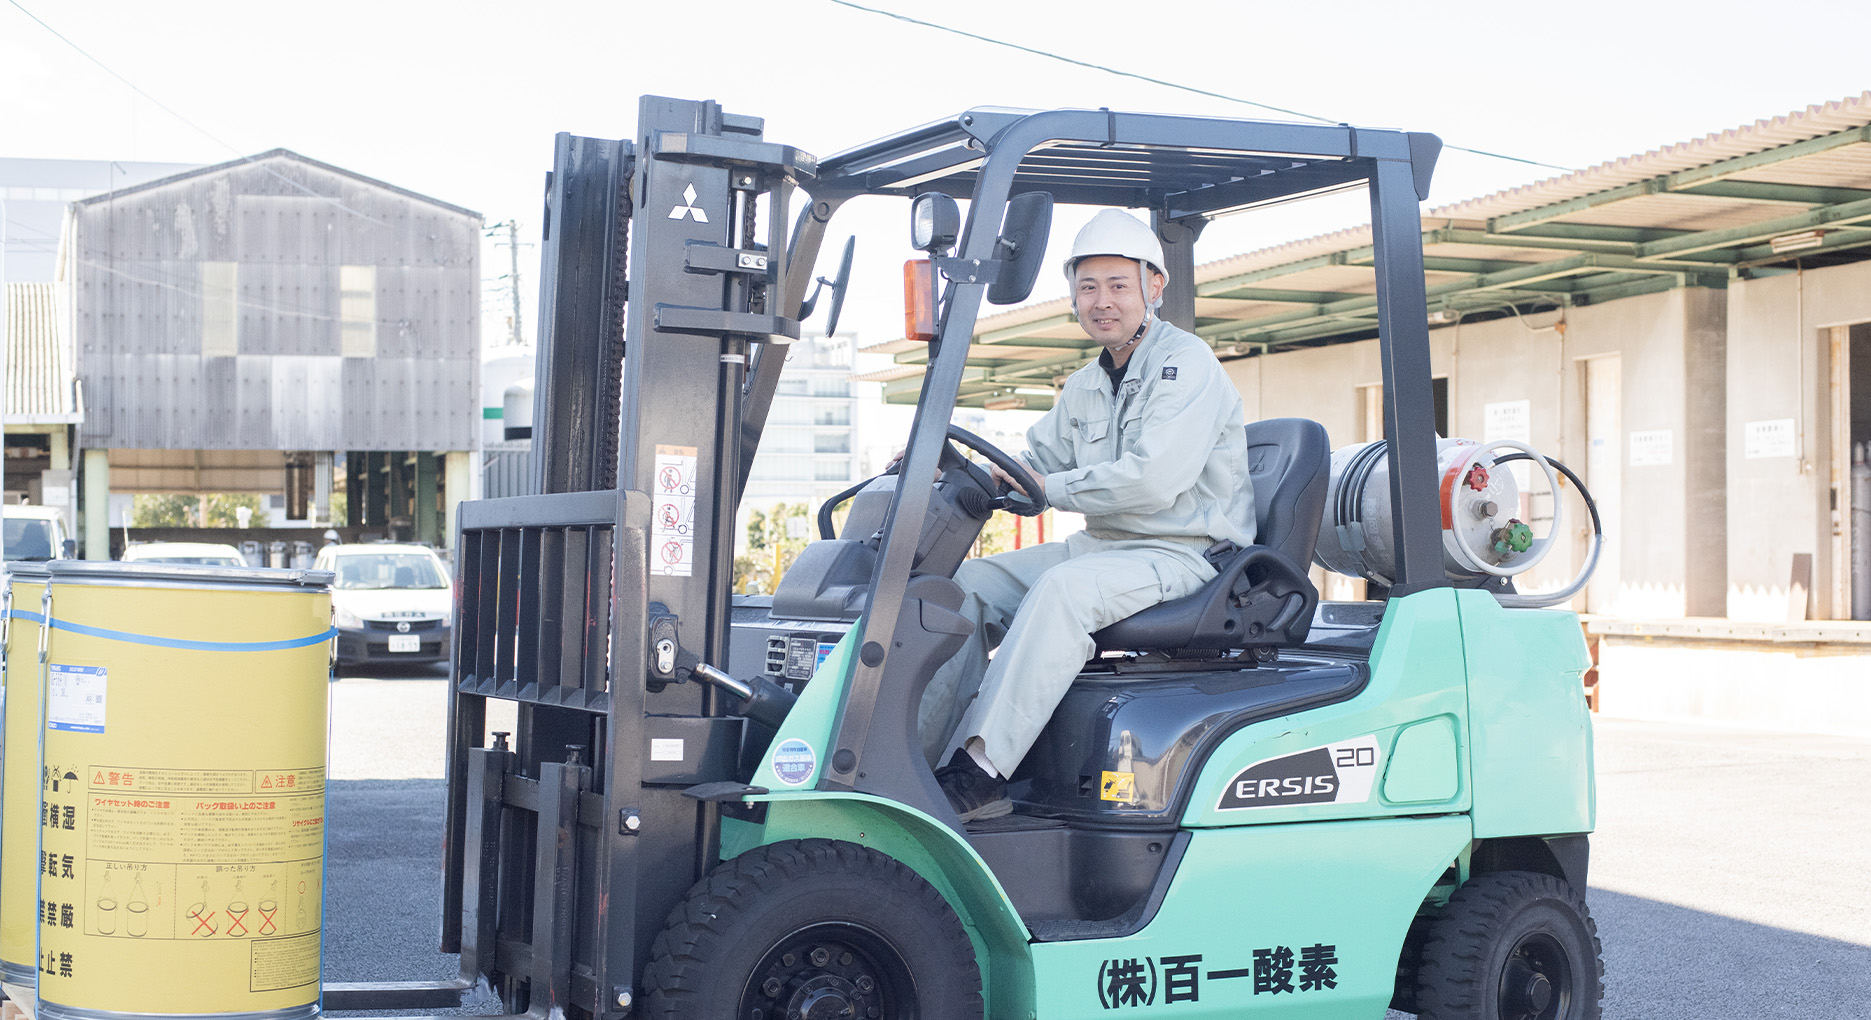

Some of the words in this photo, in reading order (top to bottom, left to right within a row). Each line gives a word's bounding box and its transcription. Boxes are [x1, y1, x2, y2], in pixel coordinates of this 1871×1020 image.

[1336, 747, 1374, 767] 20
[108, 771, 134, 786] 警告
[275, 774, 295, 788] 注意
[1235, 774, 1335, 799] ERSIS
[95, 798, 170, 809] ワイヤセット時のご注意
[106, 862, 147, 872] 正しい吊り方
[215, 865, 256, 873] 誤った吊り方
[60, 805, 76, 978] 湿気厳禁
[1097, 943, 1339, 1010] (株)百一酸素
